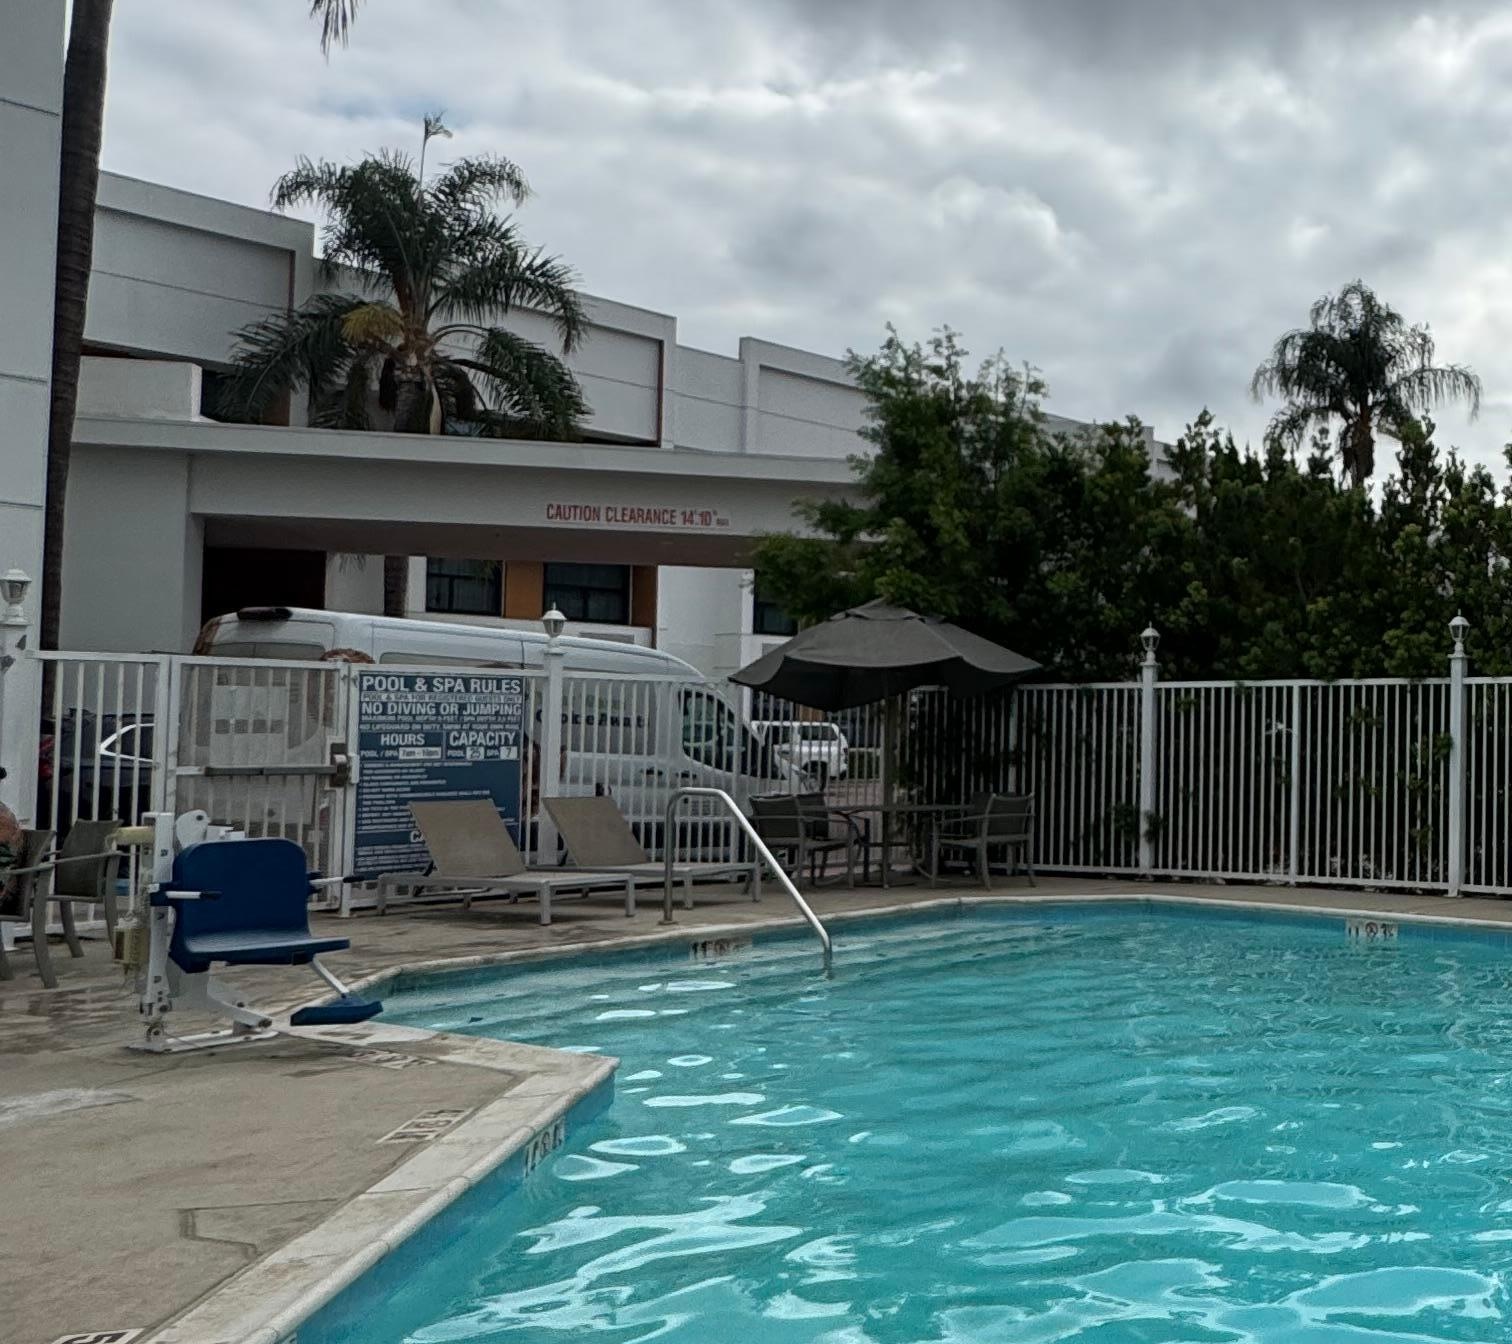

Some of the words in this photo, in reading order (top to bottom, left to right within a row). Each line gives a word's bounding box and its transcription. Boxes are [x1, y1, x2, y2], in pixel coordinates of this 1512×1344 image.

[546, 503, 600, 522] CAUTION
[605, 506, 676, 525] CLEARANCE
[362, 676, 410, 692] POOL
[415, 677, 428, 692] &
[432, 677, 466, 693] SPA
[470, 678, 521, 694] RULES
[361, 702, 383, 714] NO
[387, 702, 436, 715] DIVING
[440, 703, 459, 715] OR
[463, 703, 522, 715] JUMPING
[380, 733, 425, 746] HOURS
[449, 731, 516, 746] CAPACITY
